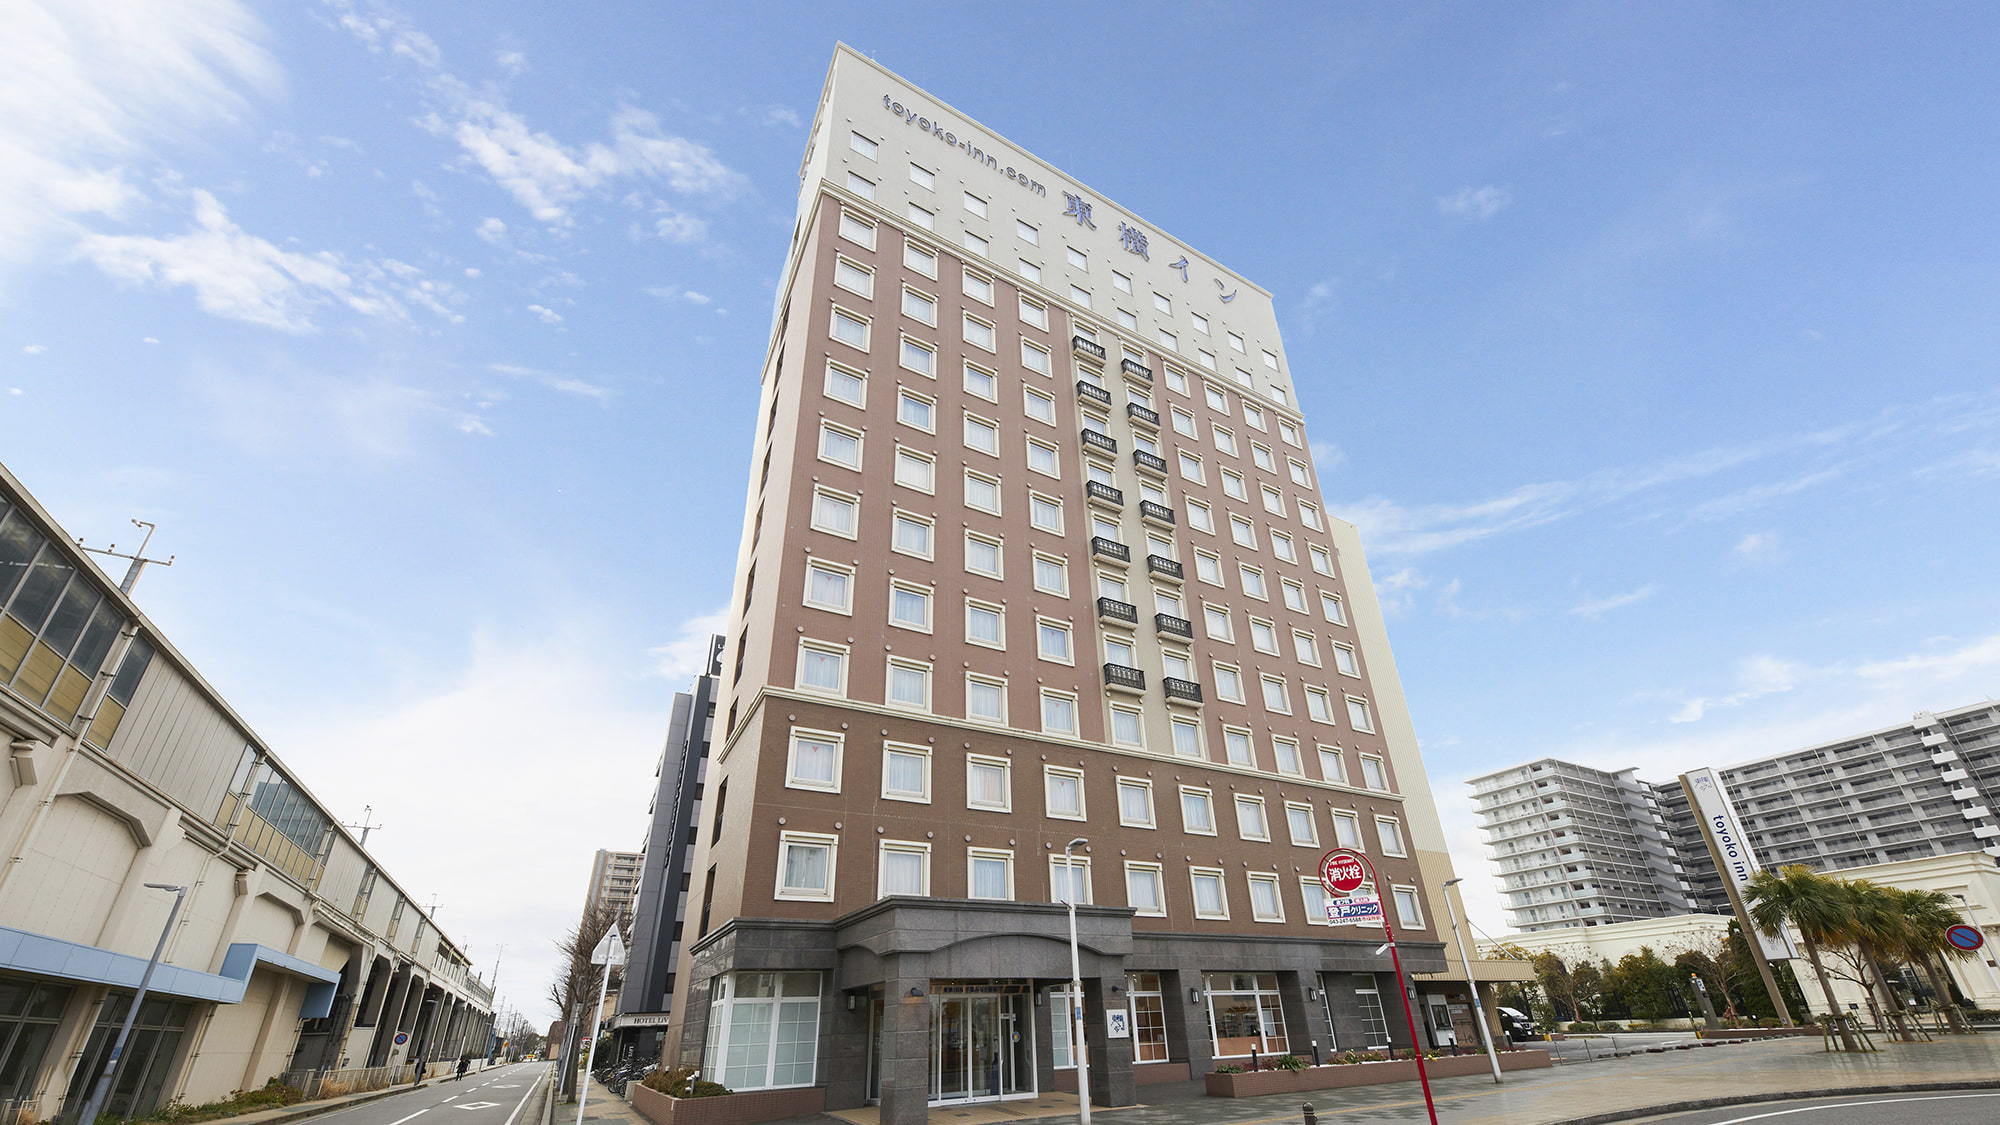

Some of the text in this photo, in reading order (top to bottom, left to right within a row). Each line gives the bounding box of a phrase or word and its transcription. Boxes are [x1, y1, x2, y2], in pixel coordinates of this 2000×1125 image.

[883, 94, 1047, 198] toyoko-inn.com
[1713, 814, 1738, 858] toyoko
[1733, 860, 1749, 882] inn
[1329, 865, 1362, 882] 消火栓
[1328, 905, 1378, 917] 登戸クリニック
